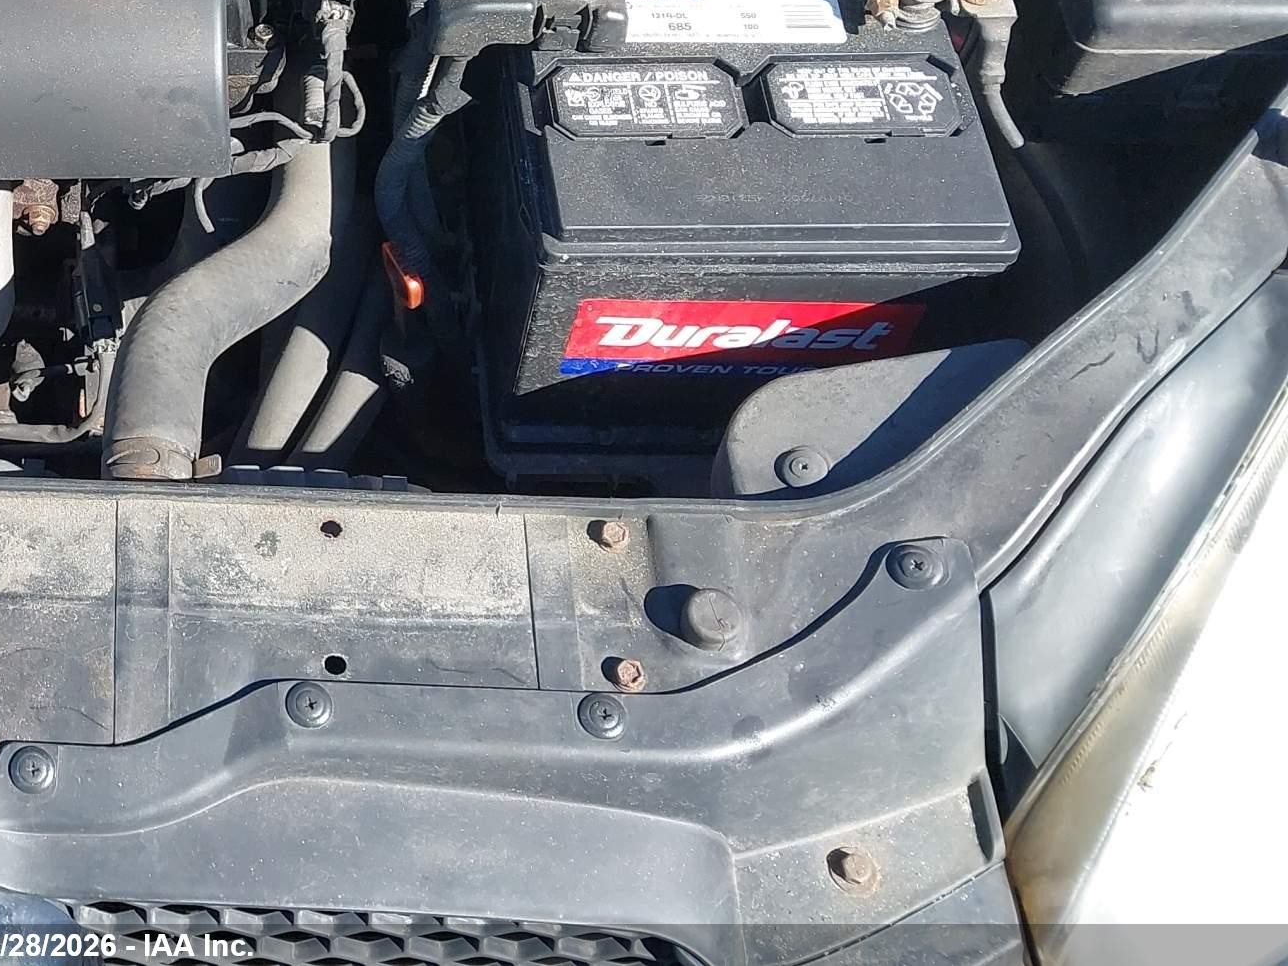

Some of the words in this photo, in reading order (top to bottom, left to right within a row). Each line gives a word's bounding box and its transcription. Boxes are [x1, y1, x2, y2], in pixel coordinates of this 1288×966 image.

[668, 22, 692, 31] 685
[583, 71, 641, 82] DANGER
[656, 70, 708, 82] POISON
[596, 318, 893, 351] Duralast
[614, 363, 733, 375] PROVEN
